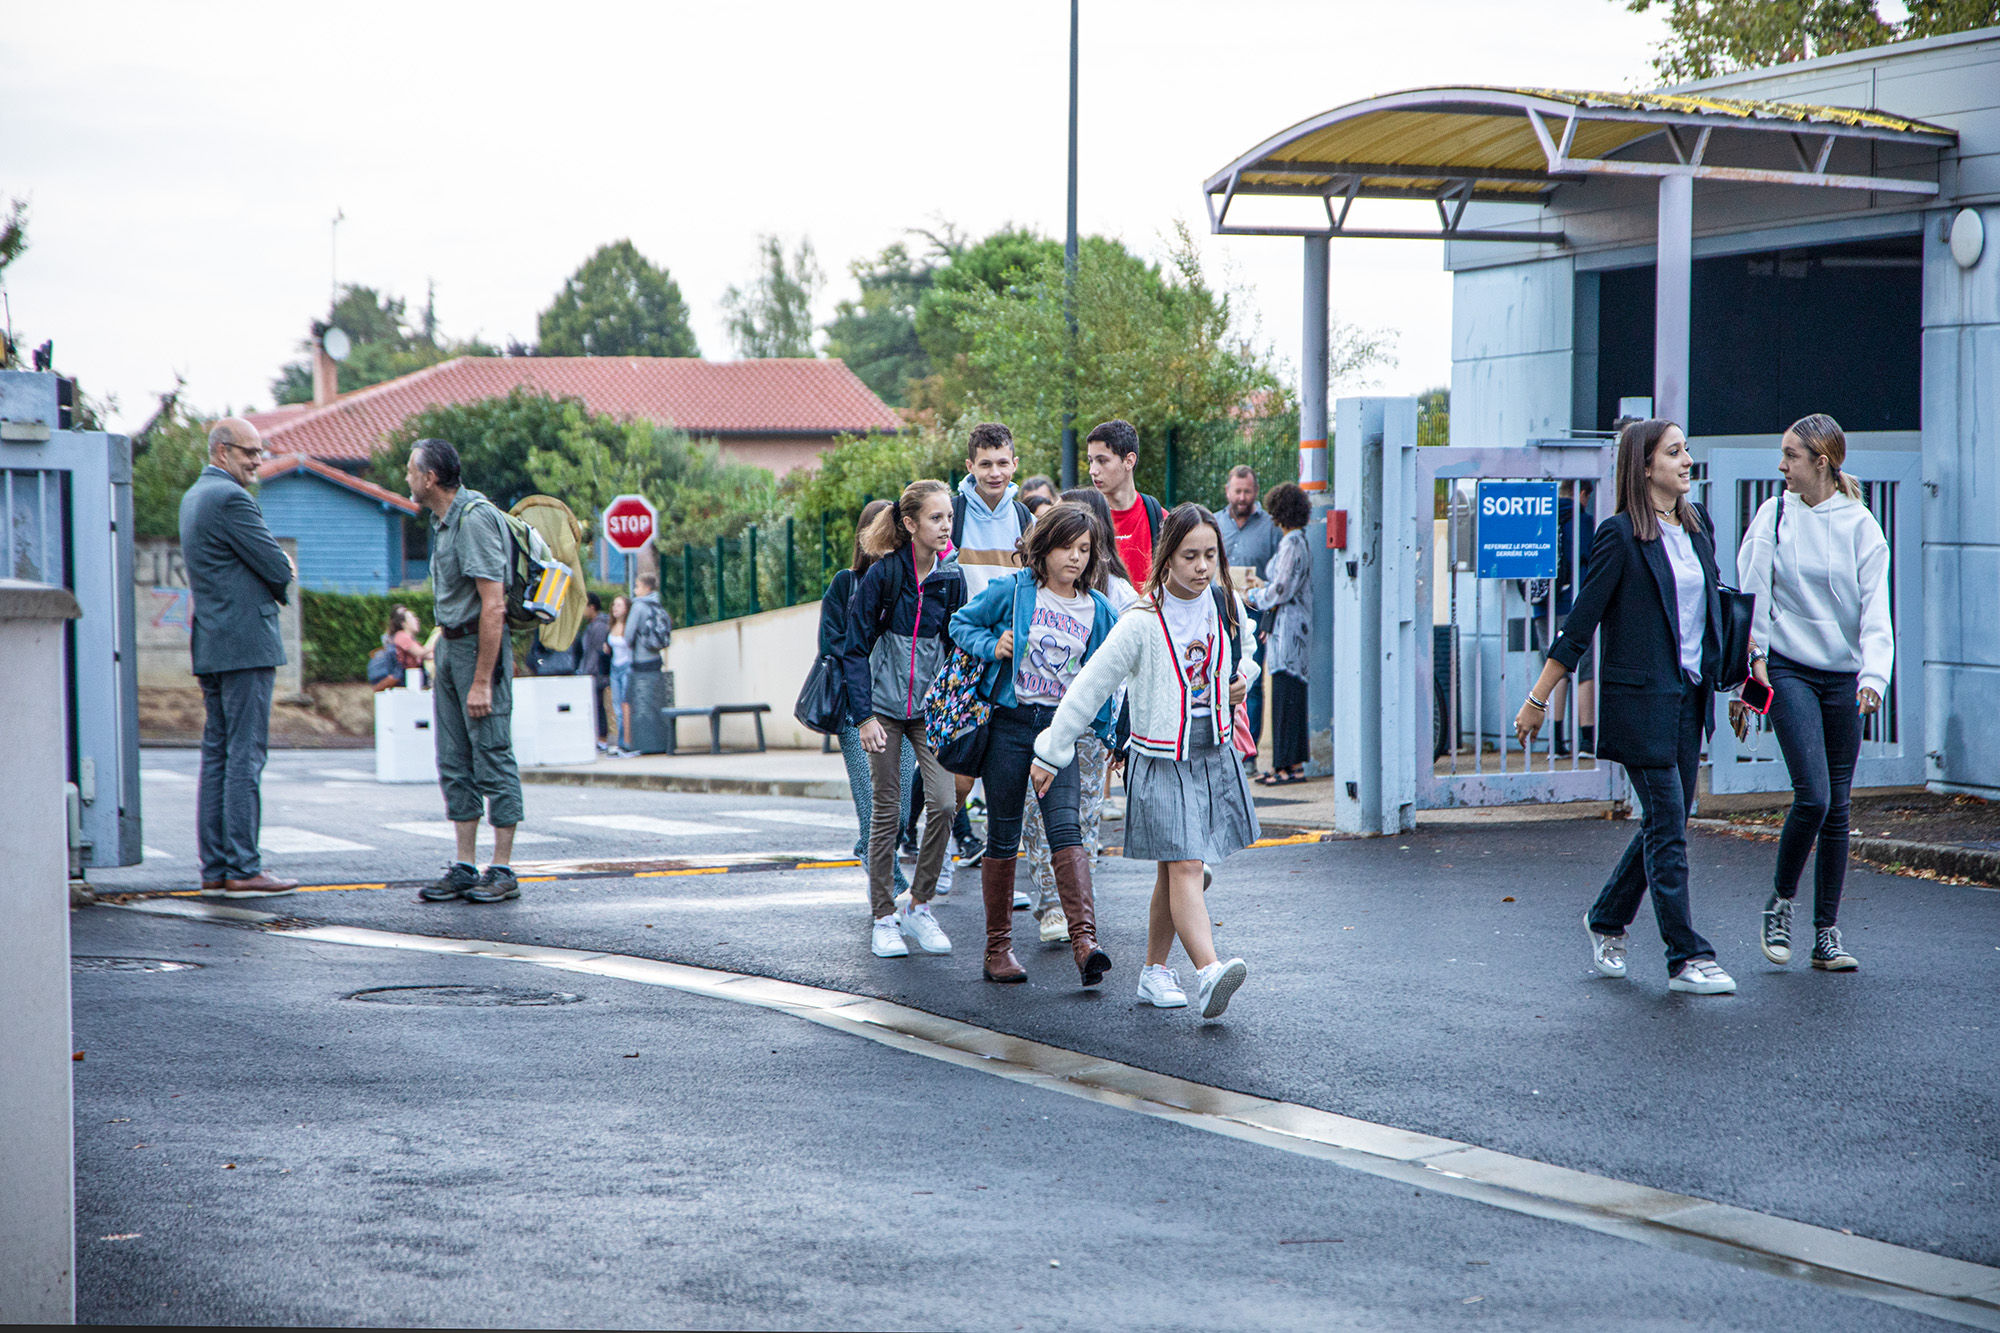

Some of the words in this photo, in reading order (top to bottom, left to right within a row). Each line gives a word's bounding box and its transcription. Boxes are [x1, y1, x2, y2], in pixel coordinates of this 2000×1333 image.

[1482, 496, 1553, 516] SORTIE
[609, 514, 650, 534] STOP
[1030, 607, 1091, 646] MICKEY
